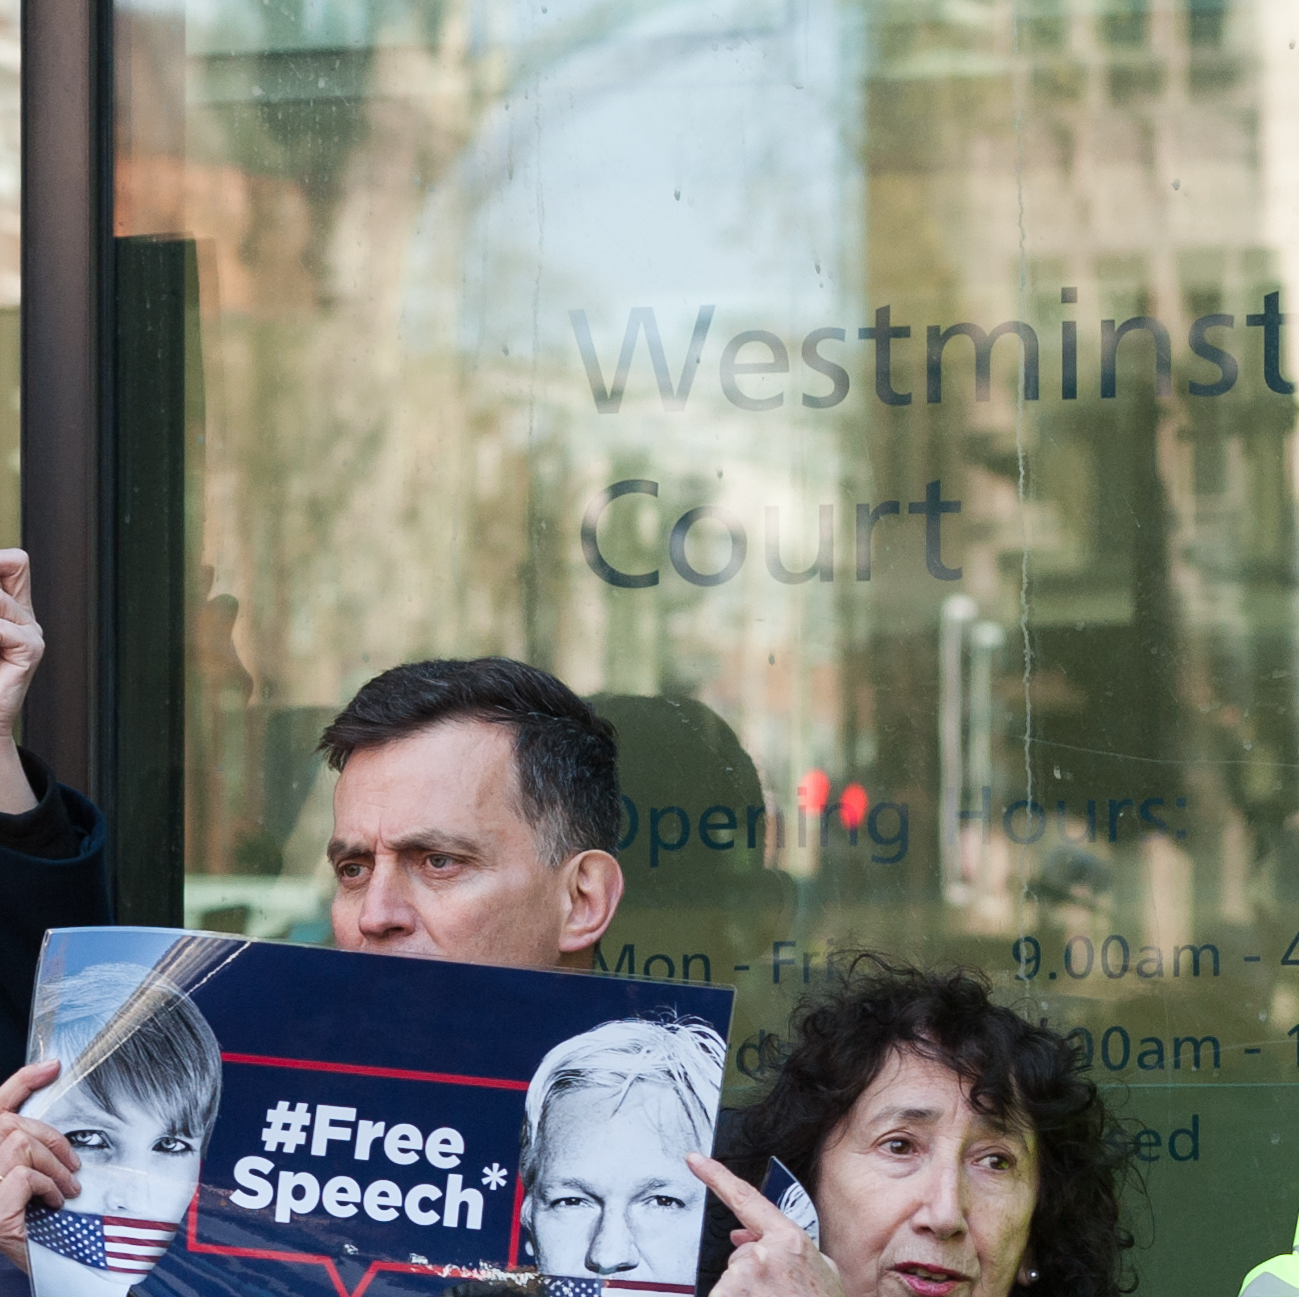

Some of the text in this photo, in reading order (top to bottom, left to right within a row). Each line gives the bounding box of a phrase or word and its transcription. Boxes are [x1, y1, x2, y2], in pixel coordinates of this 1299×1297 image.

[580, 479, 962, 588] Court
[946, 786, 1187, 841] Hours:
[1011, 935, 1220, 981] 9.00am
[260, 1100, 465, 1168] #Free
